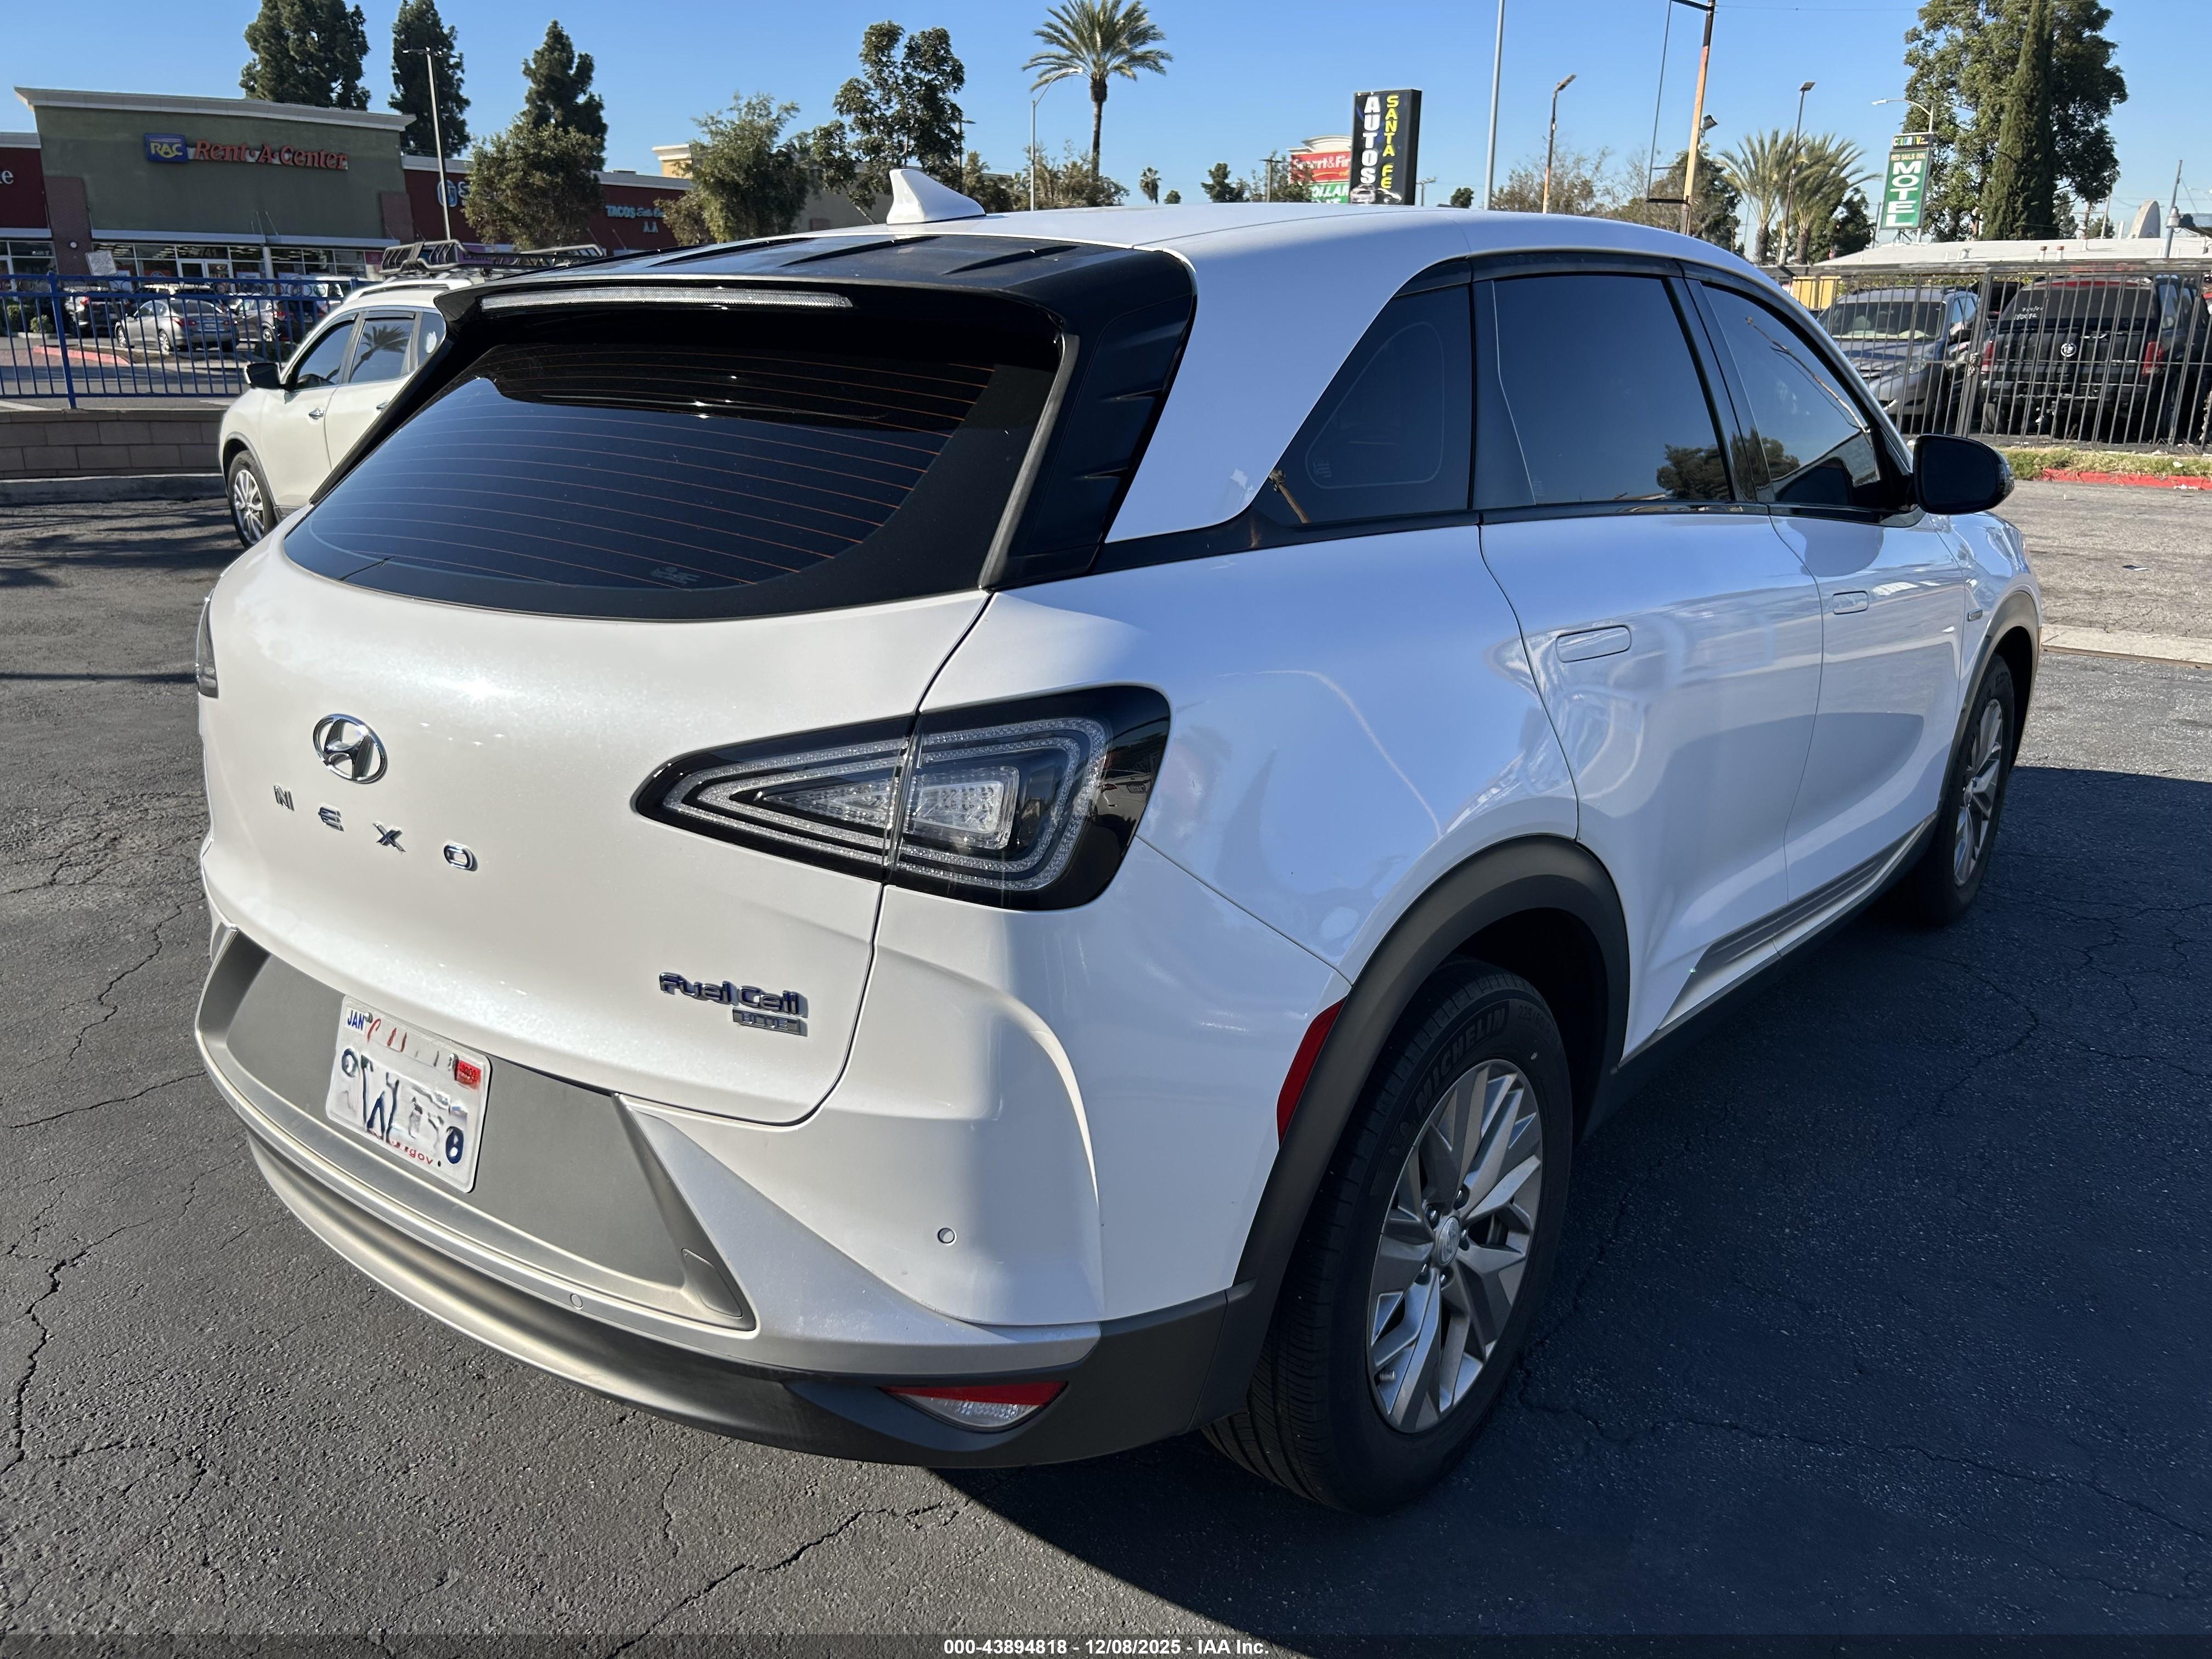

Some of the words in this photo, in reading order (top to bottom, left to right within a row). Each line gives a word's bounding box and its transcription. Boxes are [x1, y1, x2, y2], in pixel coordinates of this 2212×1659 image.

[1360, 95, 1380, 184] AUTOS
[1382, 95, 1399, 157] SANTA
[1893, 136, 1913, 146] COLOR
[150, 142, 183, 159] RAC
[1380, 164, 1393, 189] FE
[1886, 160, 1922, 227] MOTEL
[605, 205, 636, 219] TACOS
[273, 785, 478, 872] NEXO
[658, 972, 733, 1006] Fuel
[737, 985, 801, 1016] Cell
[347, 1009, 365, 1031] JAN
[1414, 1007, 1505, 1116] MICHELIN
